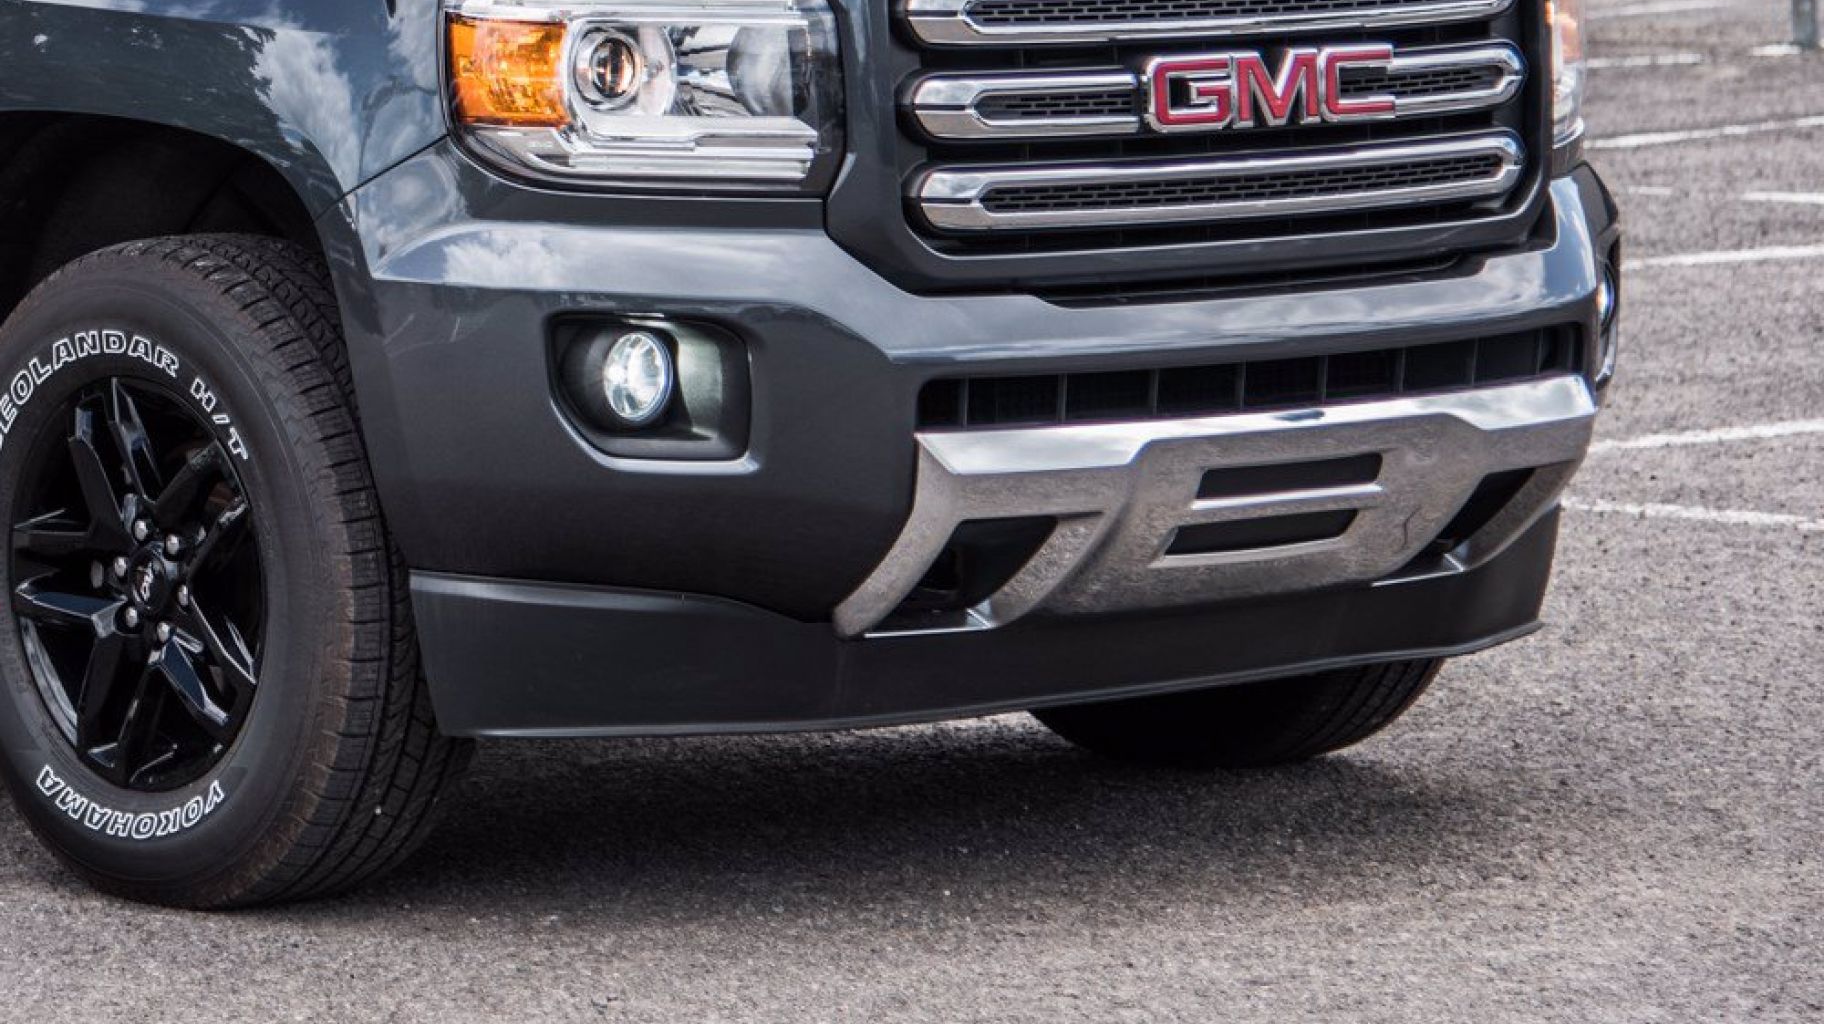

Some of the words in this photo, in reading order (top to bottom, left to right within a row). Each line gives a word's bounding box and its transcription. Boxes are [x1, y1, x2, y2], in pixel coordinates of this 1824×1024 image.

[1144, 43, 1395, 133] GMC
[189, 377, 250, 460] H/T
[36, 764, 226, 839] YOKOHAMA
